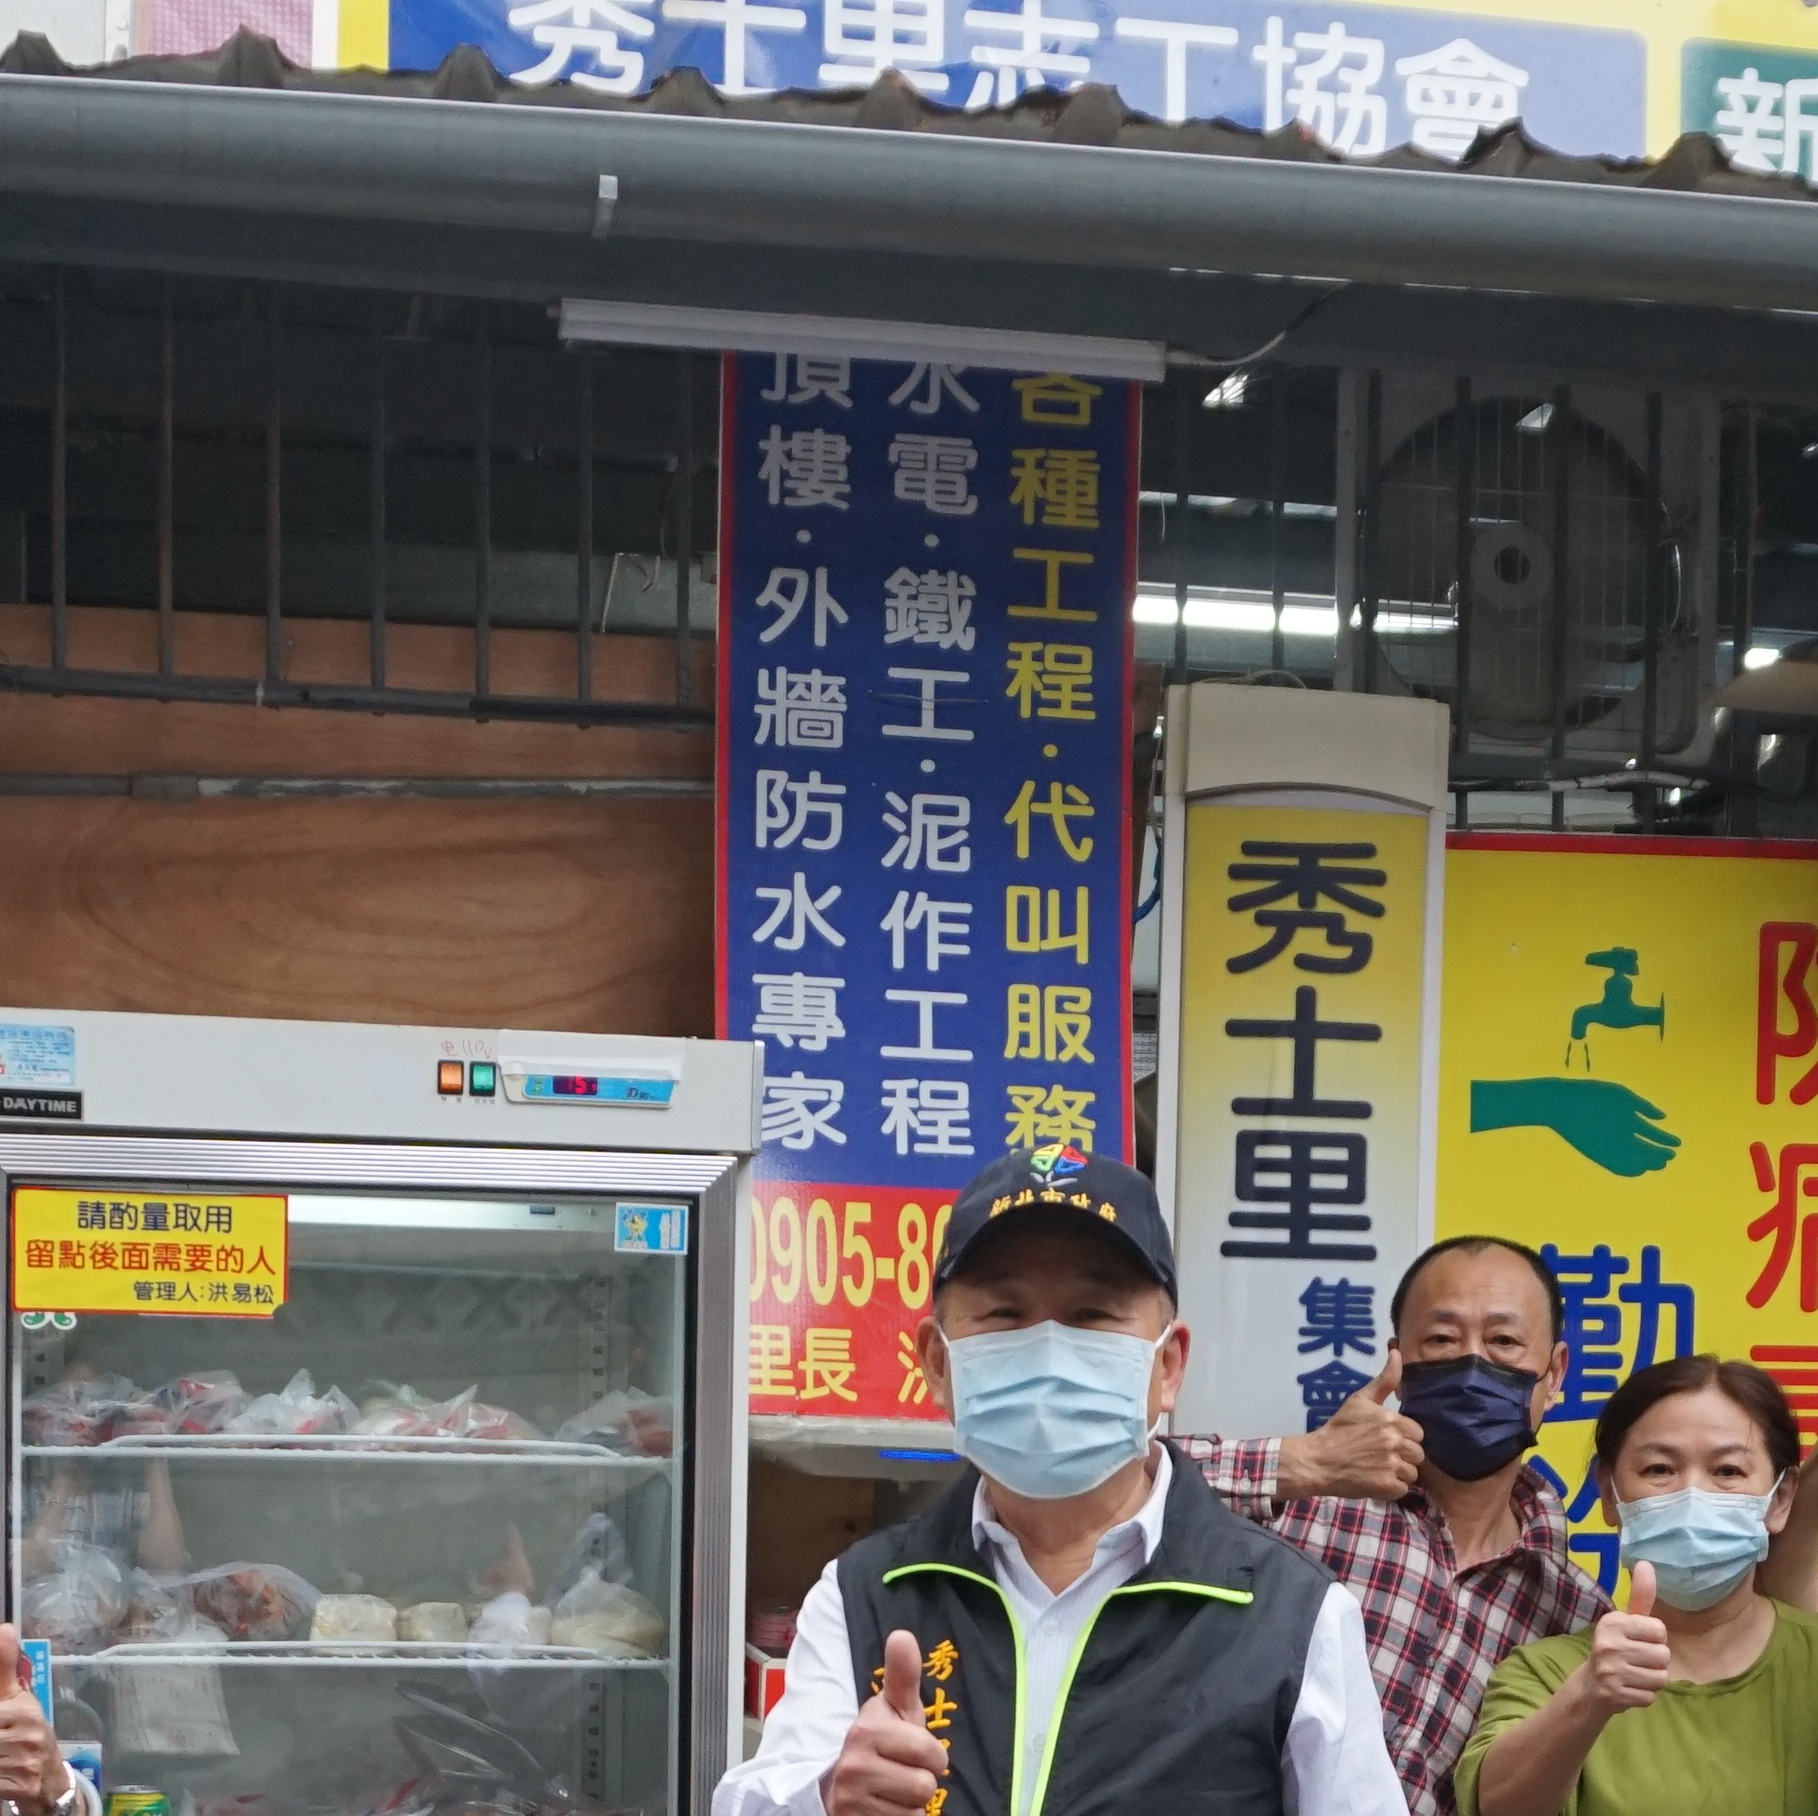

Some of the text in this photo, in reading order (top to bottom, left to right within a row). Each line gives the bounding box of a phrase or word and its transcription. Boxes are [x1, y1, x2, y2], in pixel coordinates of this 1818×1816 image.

[1219, 840, 1387, 1262] 秀士里
[2, 1096, 78, 1113] DAYTIME
[77, 1201, 233, 1233] 請酌量取用
[25, 1239, 276, 1275] 留點後面需要的人
[751, 1196, 955, 1310] 905-8
[133, 1281, 274, 1305] 管理人:洪易松
[748, 1325, 858, 1402] 里長
